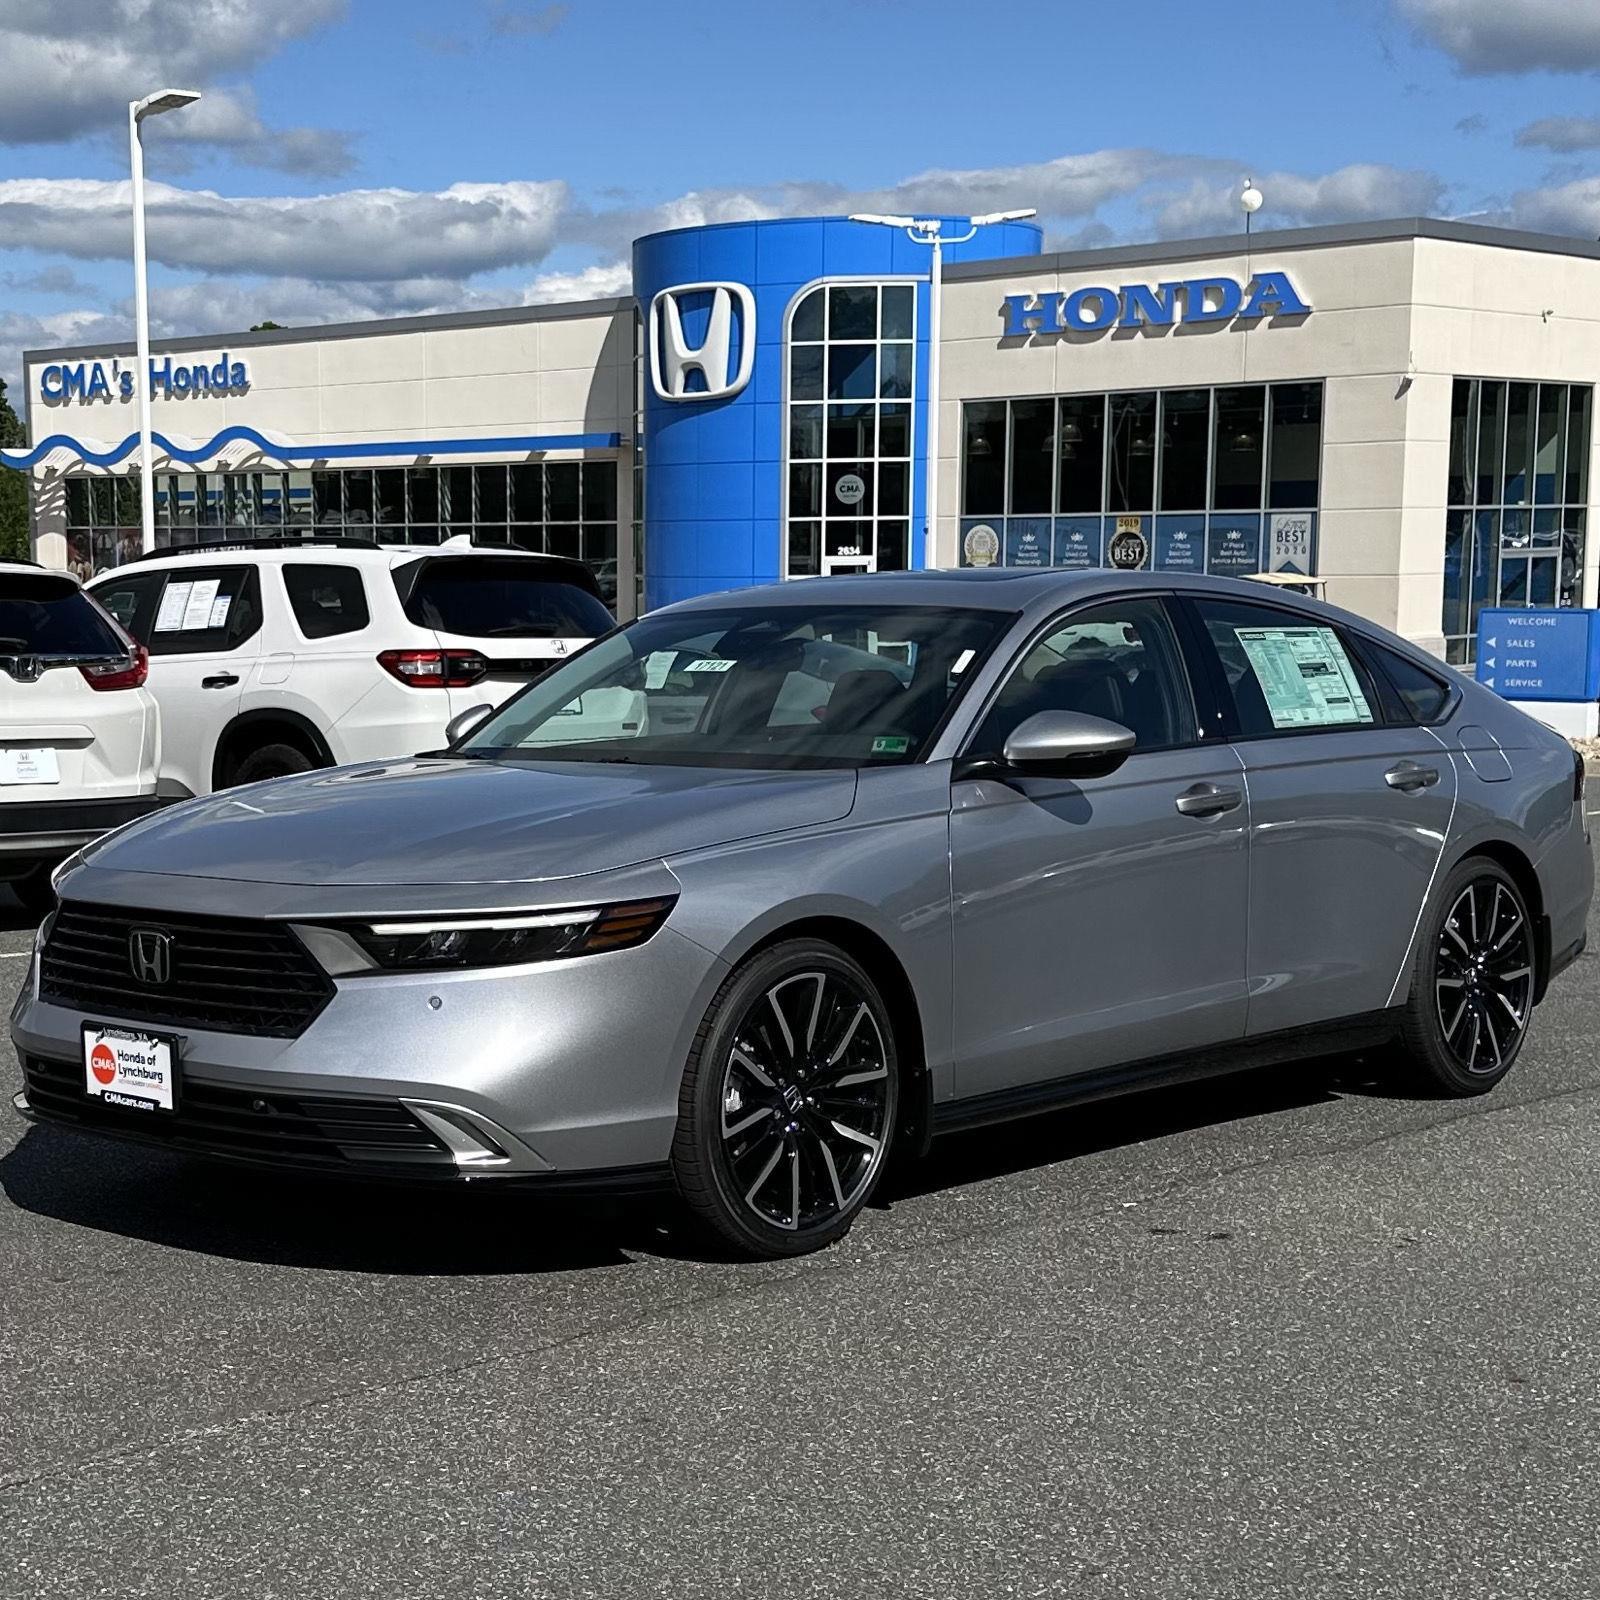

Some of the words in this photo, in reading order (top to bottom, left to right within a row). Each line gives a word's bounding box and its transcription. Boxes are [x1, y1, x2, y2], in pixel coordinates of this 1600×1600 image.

[1003, 272, 1312, 337] HONDA
[41, 359, 134, 400] CMA's
[149, 352, 247, 394] Honda
[840, 485, 860, 493] CMA
[1119, 518, 1139, 527] 2019
[1276, 530, 1306, 542] BEST
[1115, 548, 1140, 560] BEST
[1276, 545, 1306, 555] 2020
[1507, 617, 1557, 627] WELCOME
[1506, 639, 1536, 648] SALES
[1505, 659, 1538, 668] PARTS
[1504, 679, 1543, 688] SERVICE
[117, 1050, 146, 1065] Honda
[147, 1055, 156, 1066] of
[118, 1063, 163, 1084] Lynchburg
[104, 1091, 155, 1111] CMAcars.com
